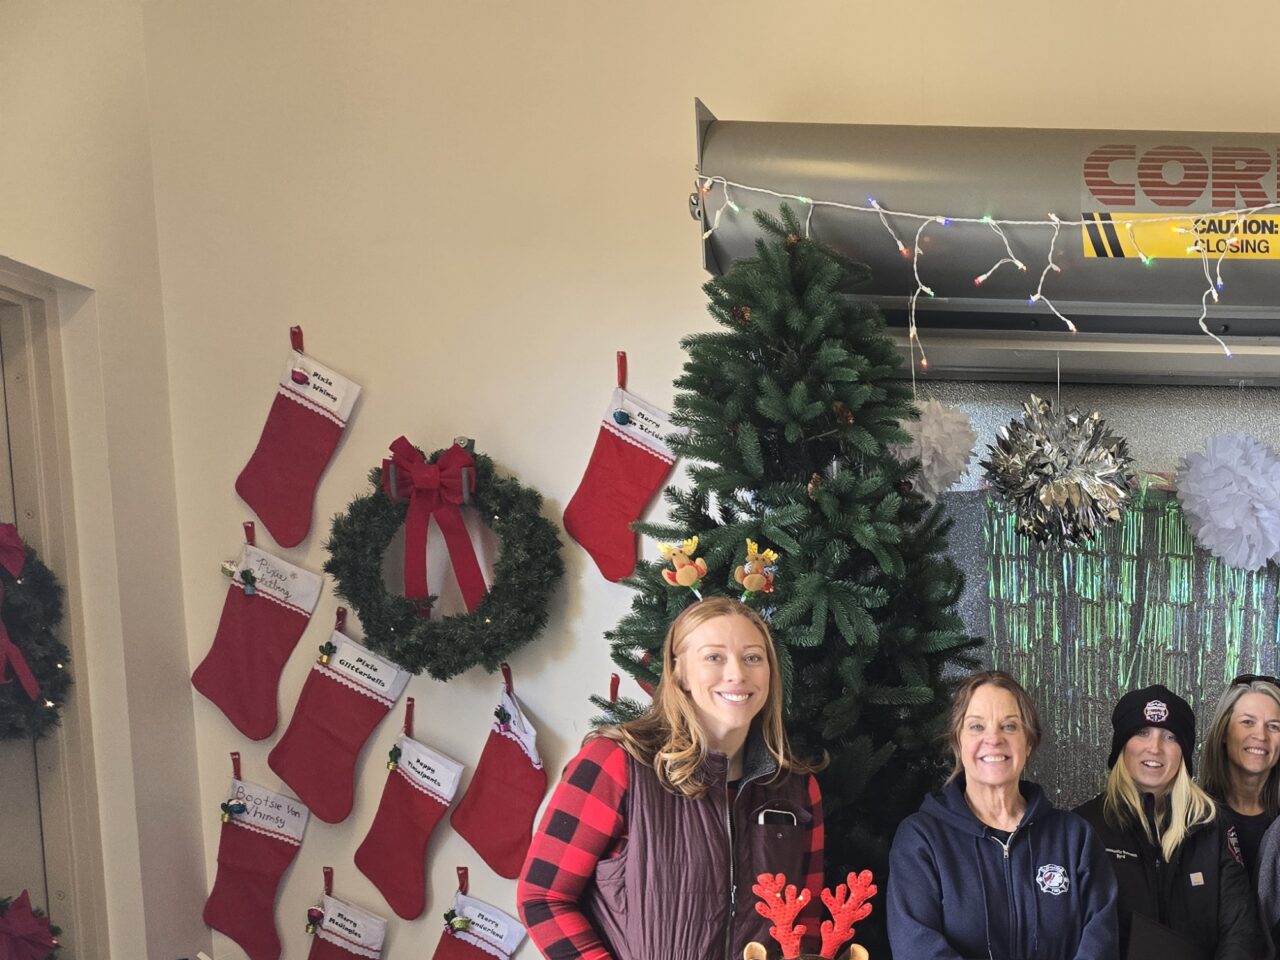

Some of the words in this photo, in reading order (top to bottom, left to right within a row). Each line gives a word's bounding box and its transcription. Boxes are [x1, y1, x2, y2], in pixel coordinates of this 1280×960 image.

[1194, 219, 1279, 235] CAUTION:
[1194, 238, 1270, 254] CLOSING
[312, 371, 333, 386] Pixie
[312, 384, 338, 402] Whimsy
[637, 411, 661, 428] Merry
[355, 656, 379, 673] Pixie
[338, 659, 386, 687] Glitterbells
[236, 786, 283, 811] Bootsie
[287, 804, 301, 818] Von
[337, 912, 357, 928] Merry
[477, 912, 499, 928] Merry
